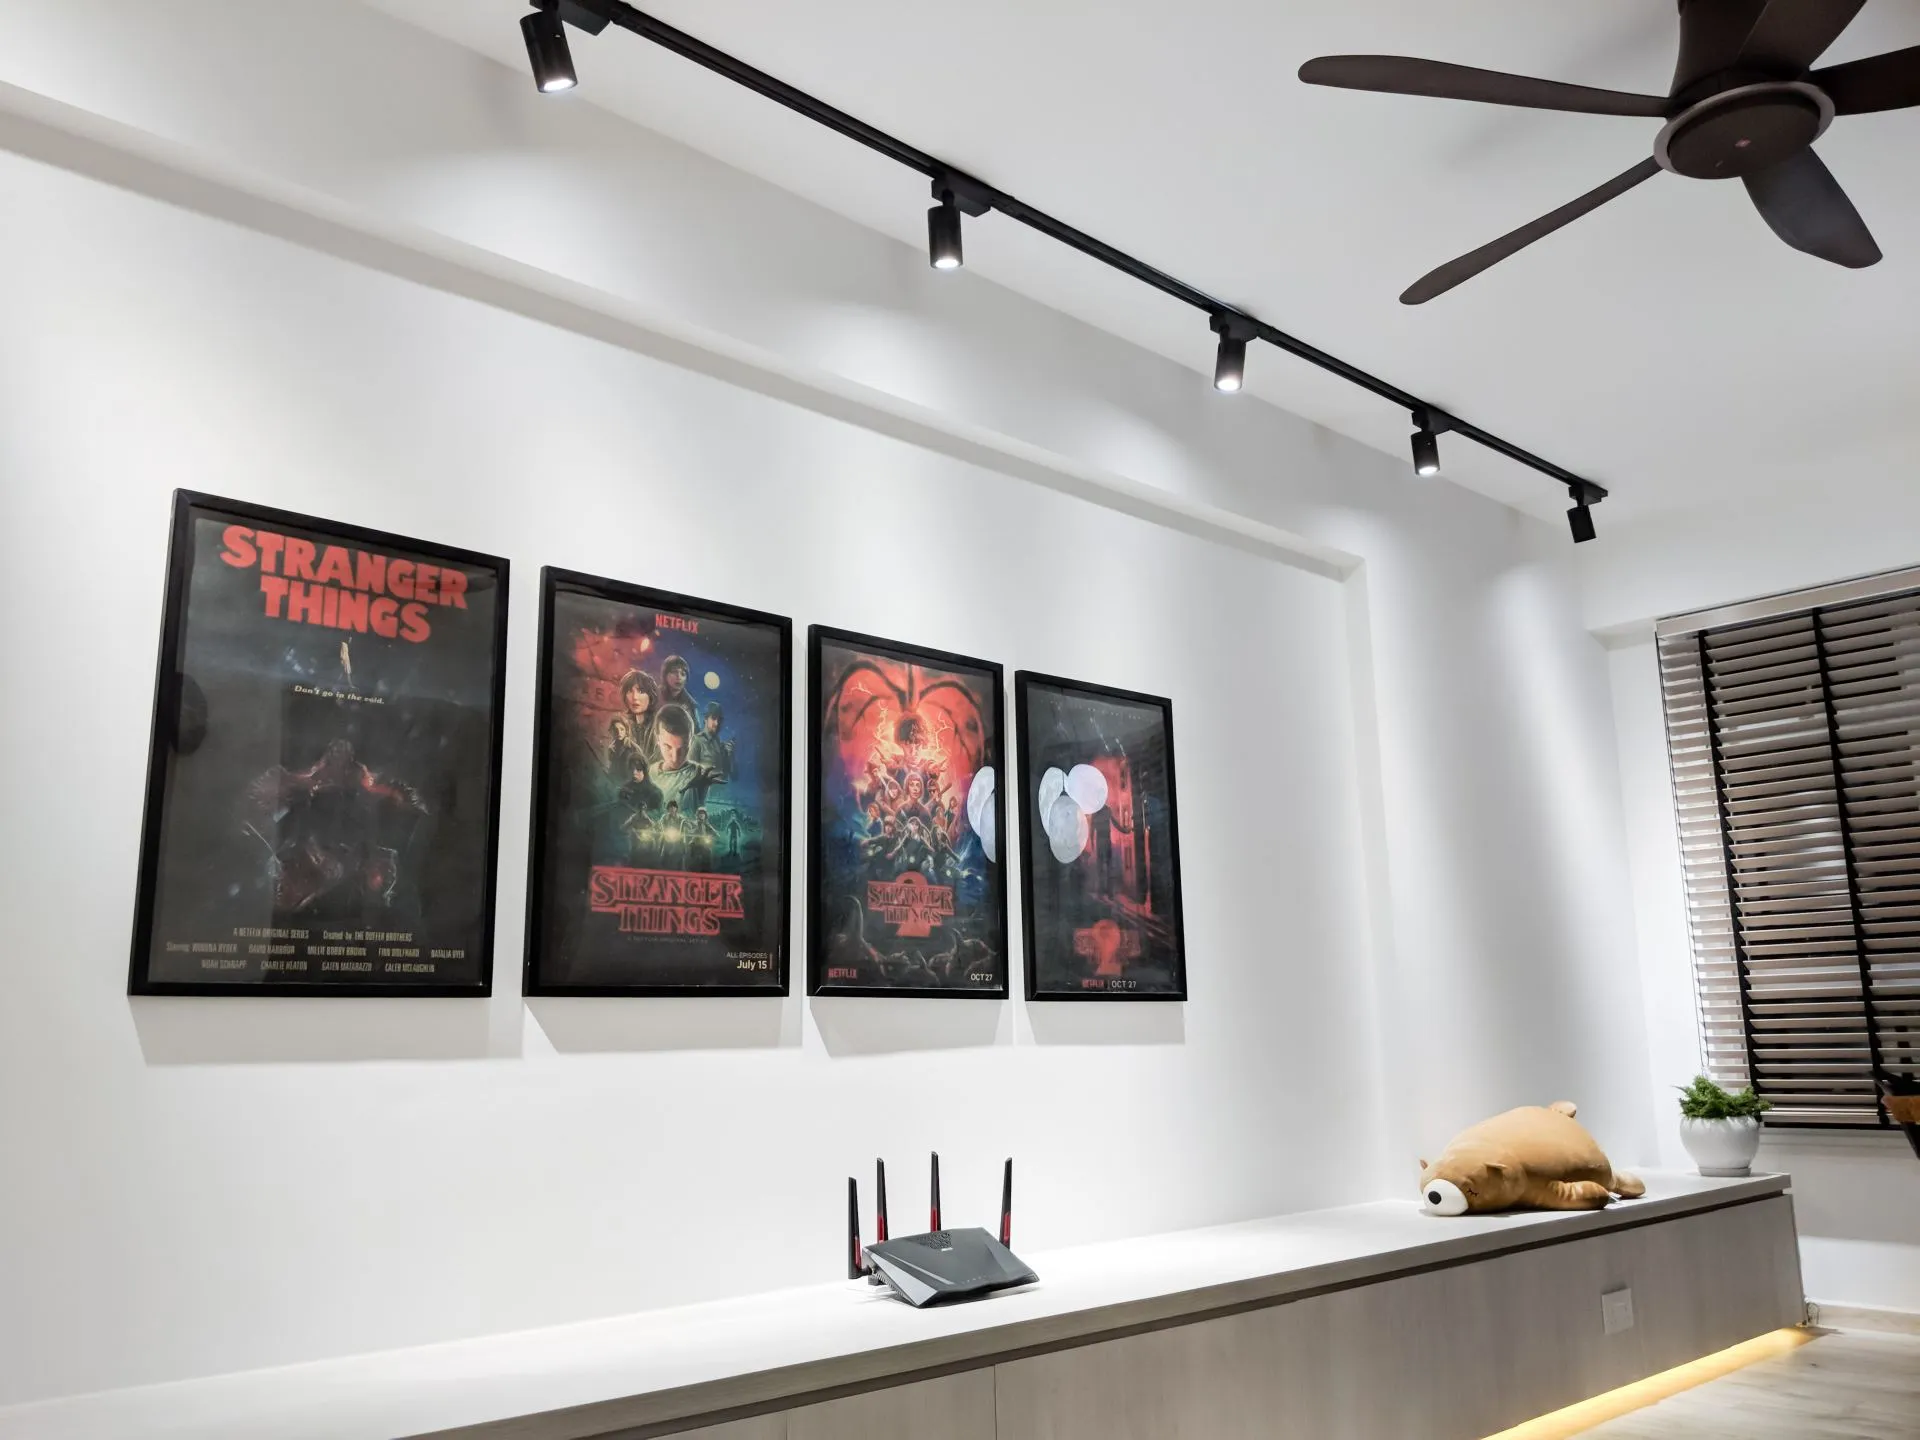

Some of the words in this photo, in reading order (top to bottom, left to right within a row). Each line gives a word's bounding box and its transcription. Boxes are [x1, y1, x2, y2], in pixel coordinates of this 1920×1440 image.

[220, 524, 468, 609] STRANGER
[260, 575, 431, 643] THINGS
[655, 613, 699, 634] NETFLIX
[294, 685, 320, 695] Don't
[347, 693, 362, 701] the
[592, 870, 744, 914] STRANGER
[868, 883, 954, 911] STRANGER
[619, 904, 720, 936] THINGS
[726, 951, 738, 959] ALL
[739, 951, 768, 959] EPISODES
[736, 959, 756, 971] July
[758, 960, 768, 970] 15
[828, 968, 857, 979] NETFLIX
[970, 973, 985, 981] OCT
[985, 973, 993, 981] 27
[1111, 980, 1126, 988] OCT
[1127, 980, 1137, 988] 27
